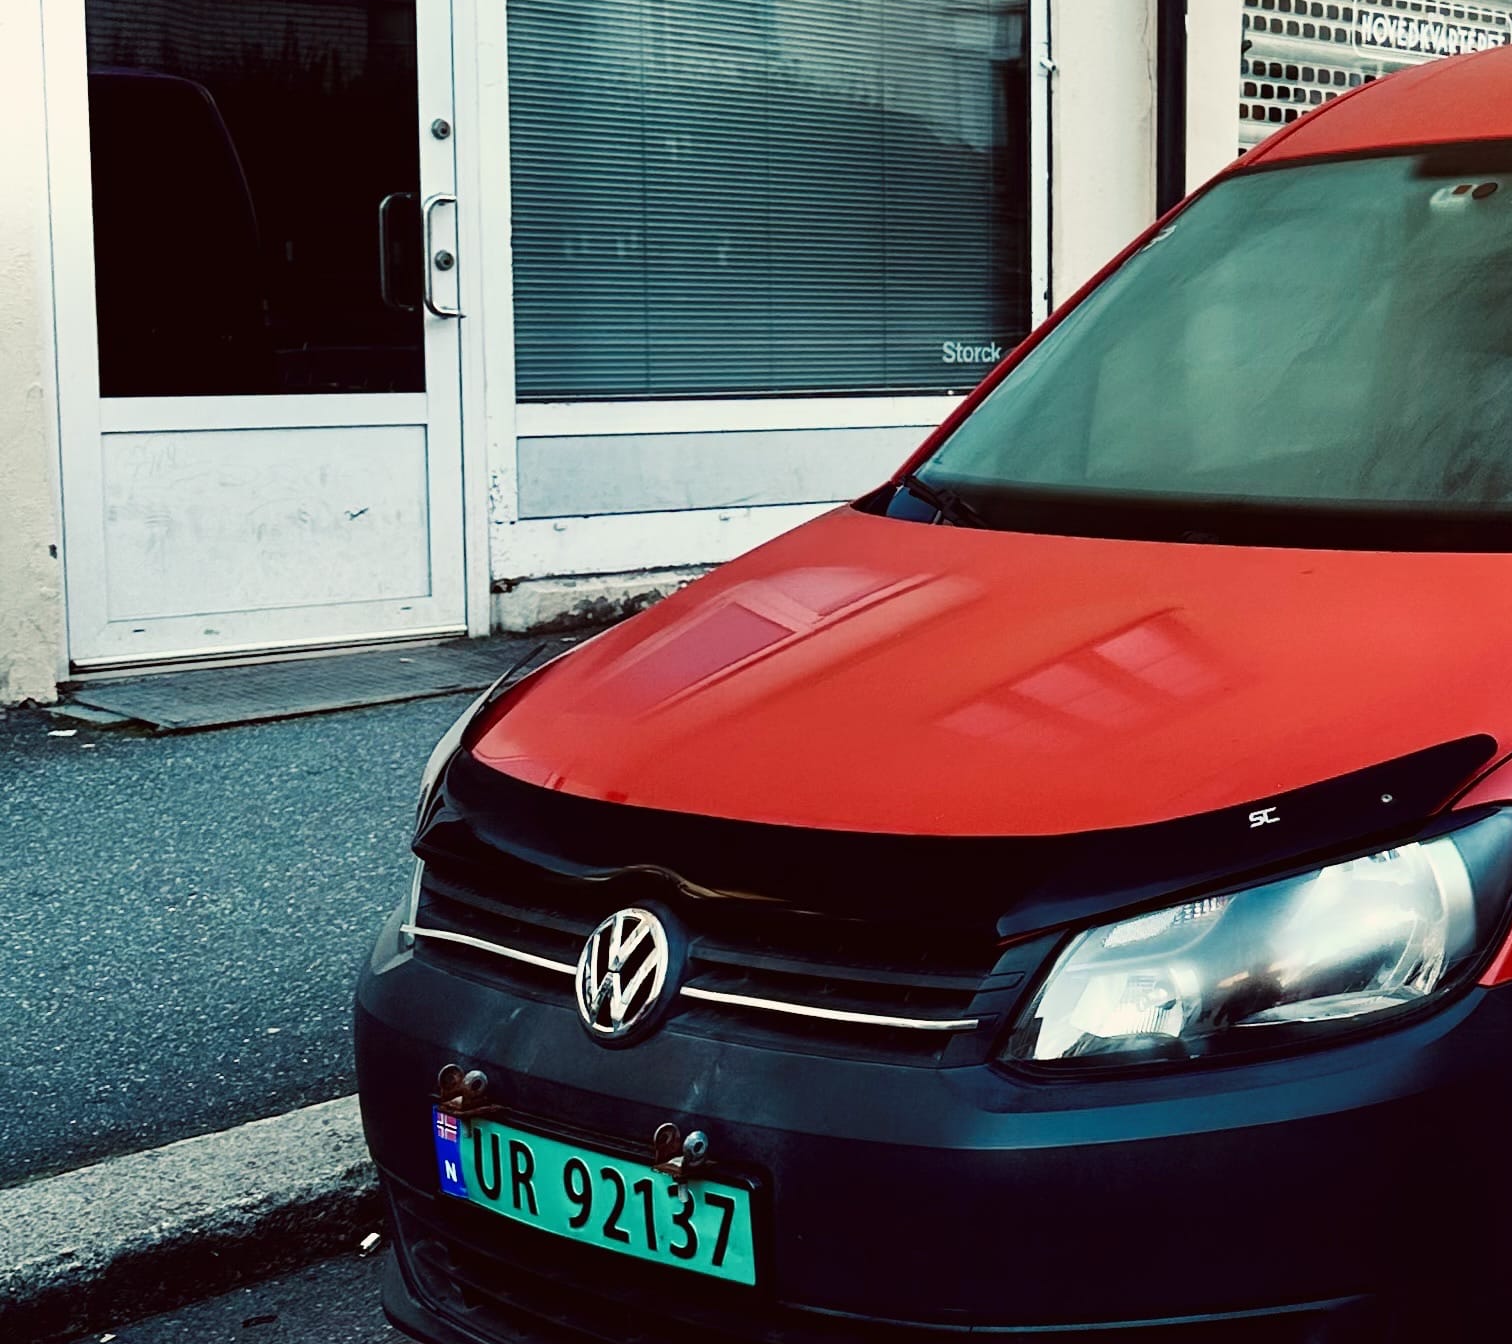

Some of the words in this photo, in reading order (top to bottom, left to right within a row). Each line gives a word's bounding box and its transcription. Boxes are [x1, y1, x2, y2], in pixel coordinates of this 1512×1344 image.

[942, 341, 1002, 363] Storck
[444, 1159, 458, 1183] N
[473, 1126, 540, 1216] UR
[563, 1156, 736, 1268] 92137
